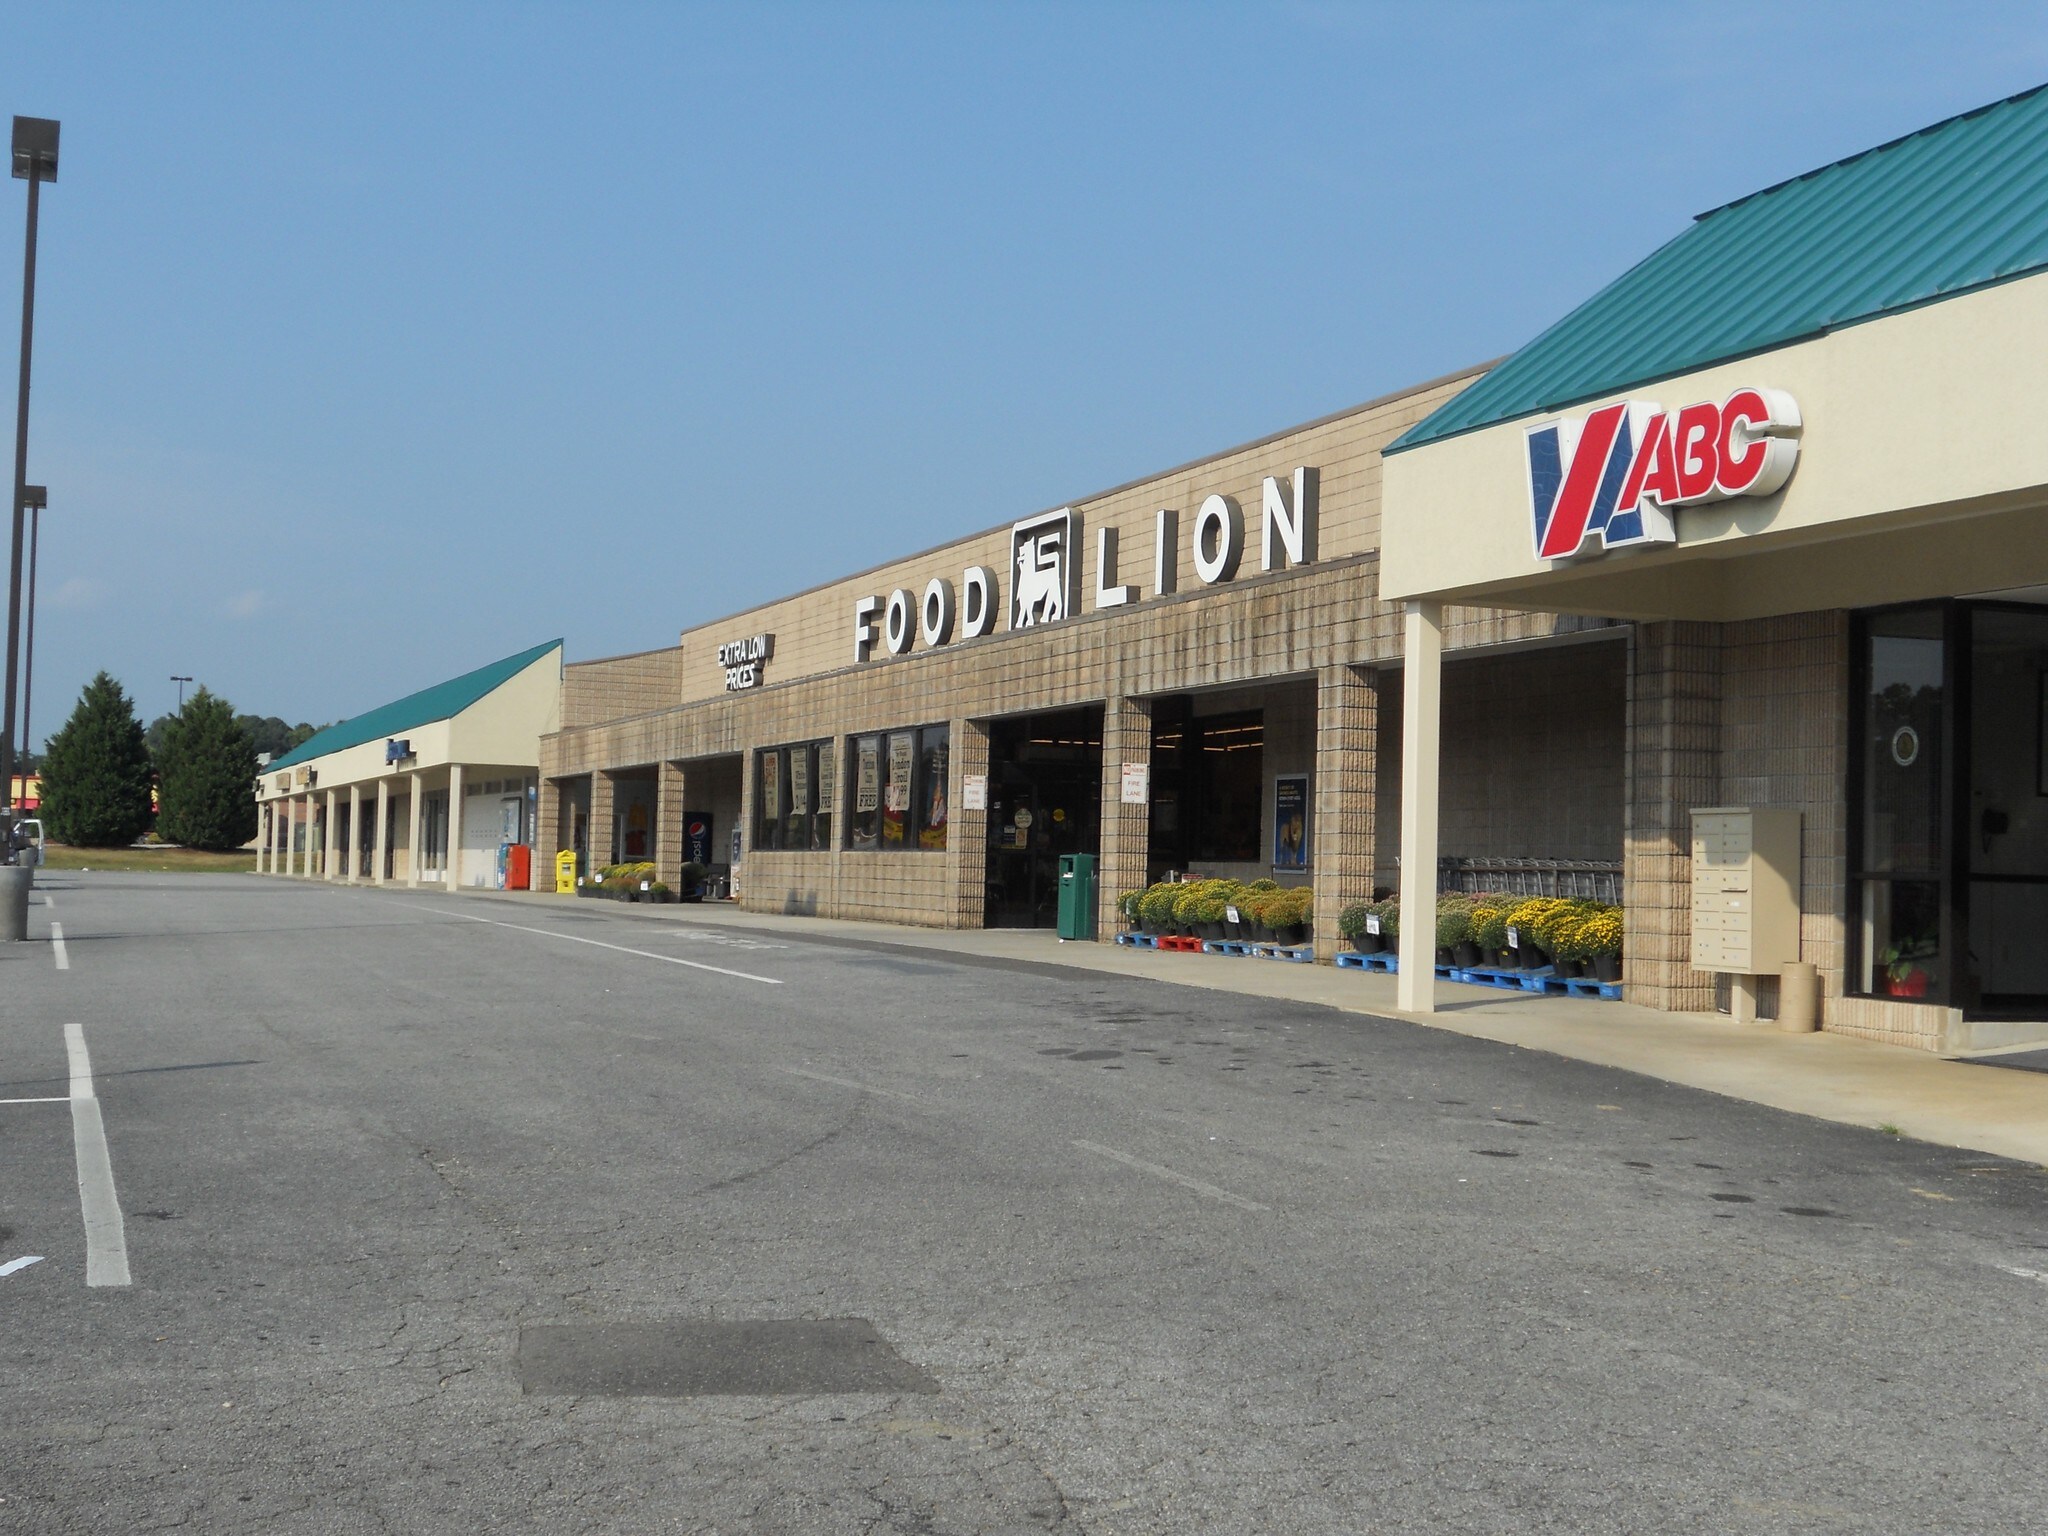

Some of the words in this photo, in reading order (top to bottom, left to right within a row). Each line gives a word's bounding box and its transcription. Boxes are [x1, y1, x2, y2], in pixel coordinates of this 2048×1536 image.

[1616, 387, 1782, 512] ABC
[854, 566, 993, 663] FOOD
[1096, 466, 1312, 608] LION
[718, 640, 746, 667] EXTRA
[748, 634, 767, 660] LOW
[725, 664, 755, 691] PRICES
[859, 794, 877, 807] FREE
[692, 841, 703, 863] epsi
